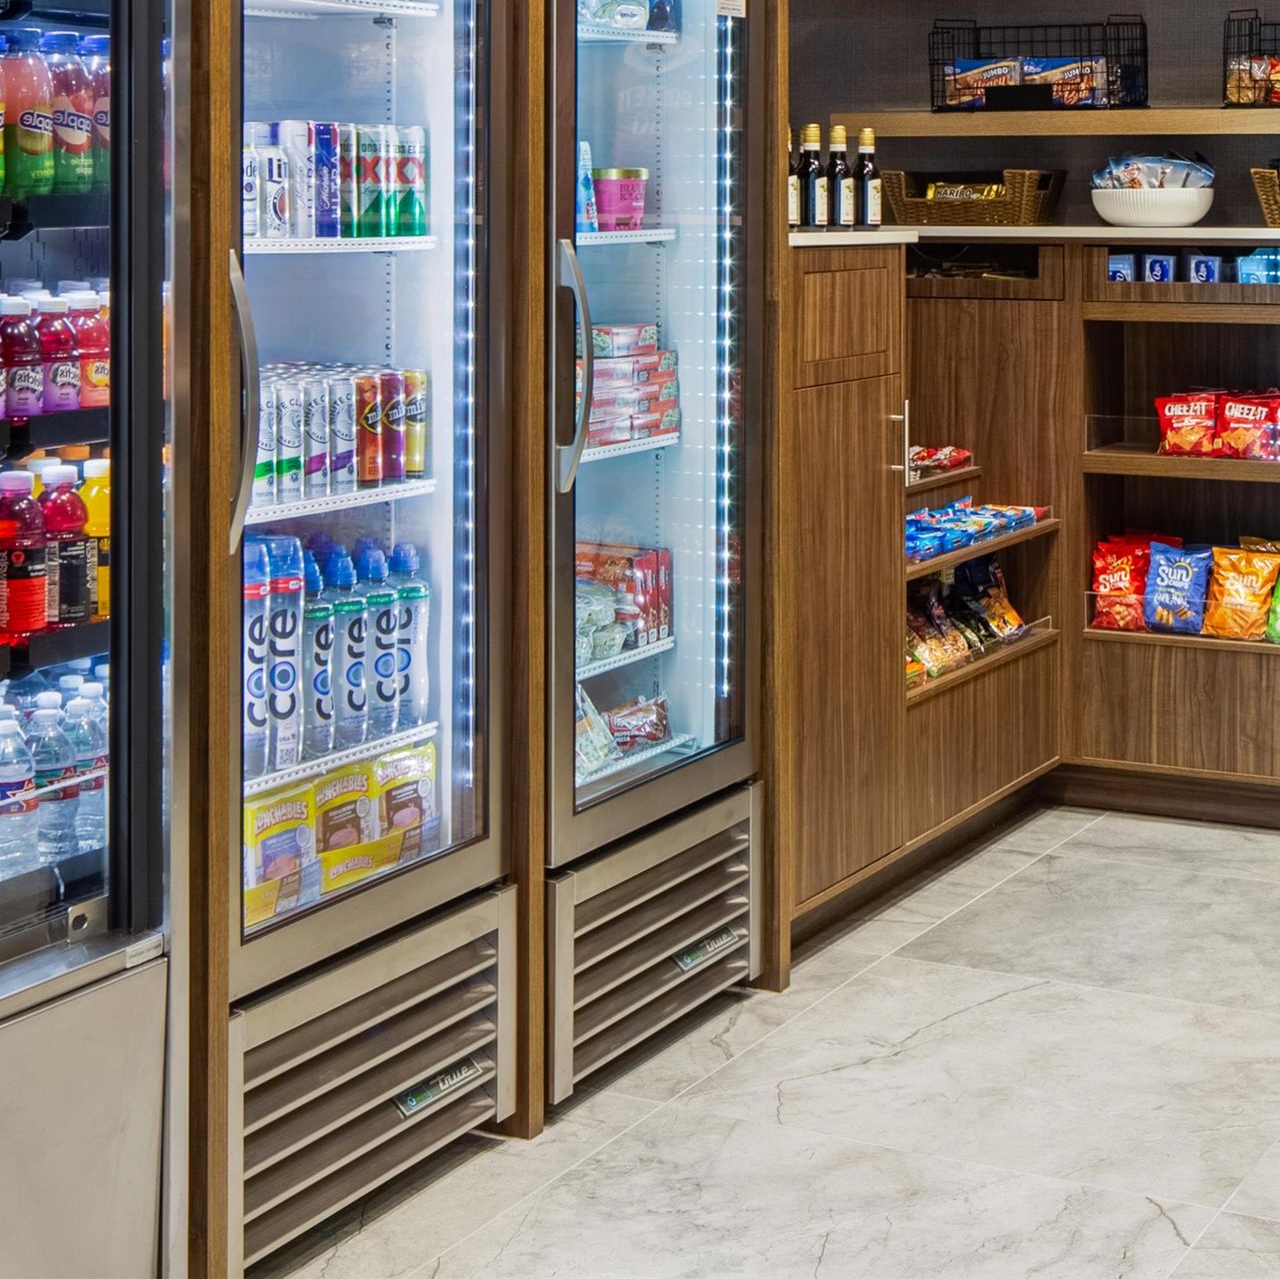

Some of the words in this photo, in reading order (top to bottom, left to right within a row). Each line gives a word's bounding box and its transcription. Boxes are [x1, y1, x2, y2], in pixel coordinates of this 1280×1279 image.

[982, 66, 1009, 80] JUMBO
[936, 186, 972, 199] HARIBO
[1164, 402, 1207, 416] CHEEZ-IT
[1225, 402, 1268, 420] CHEEZ-IT
[1156, 566, 1191, 586] Sun
[270, 608, 297, 720] core
[347, 615, 366, 712] core
[375, 608, 396, 703] core
[317, 774, 369, 804] LUNCHABLES
[255, 802, 309, 834] LUNCHABLES
